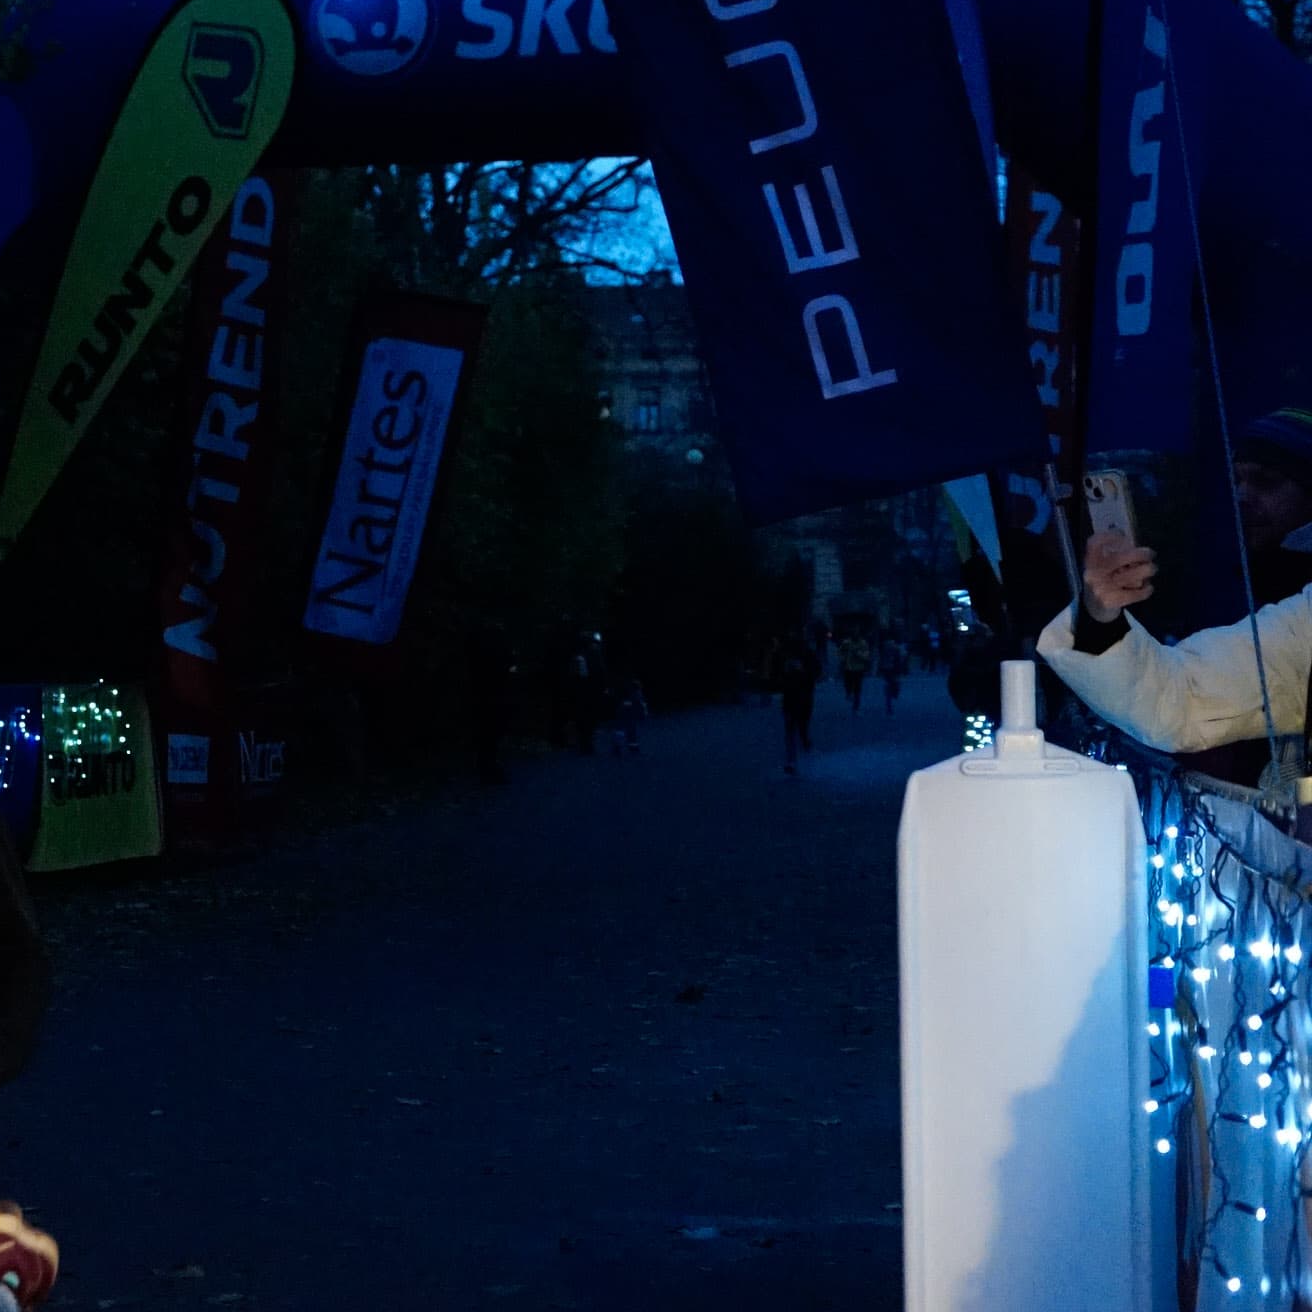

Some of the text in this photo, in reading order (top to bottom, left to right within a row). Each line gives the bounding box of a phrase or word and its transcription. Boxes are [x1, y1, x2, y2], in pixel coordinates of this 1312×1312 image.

[47, 176, 212, 423] RUNTO
[161, 175, 276, 664] NUTREND
[316, 370, 428, 615] Nartes
